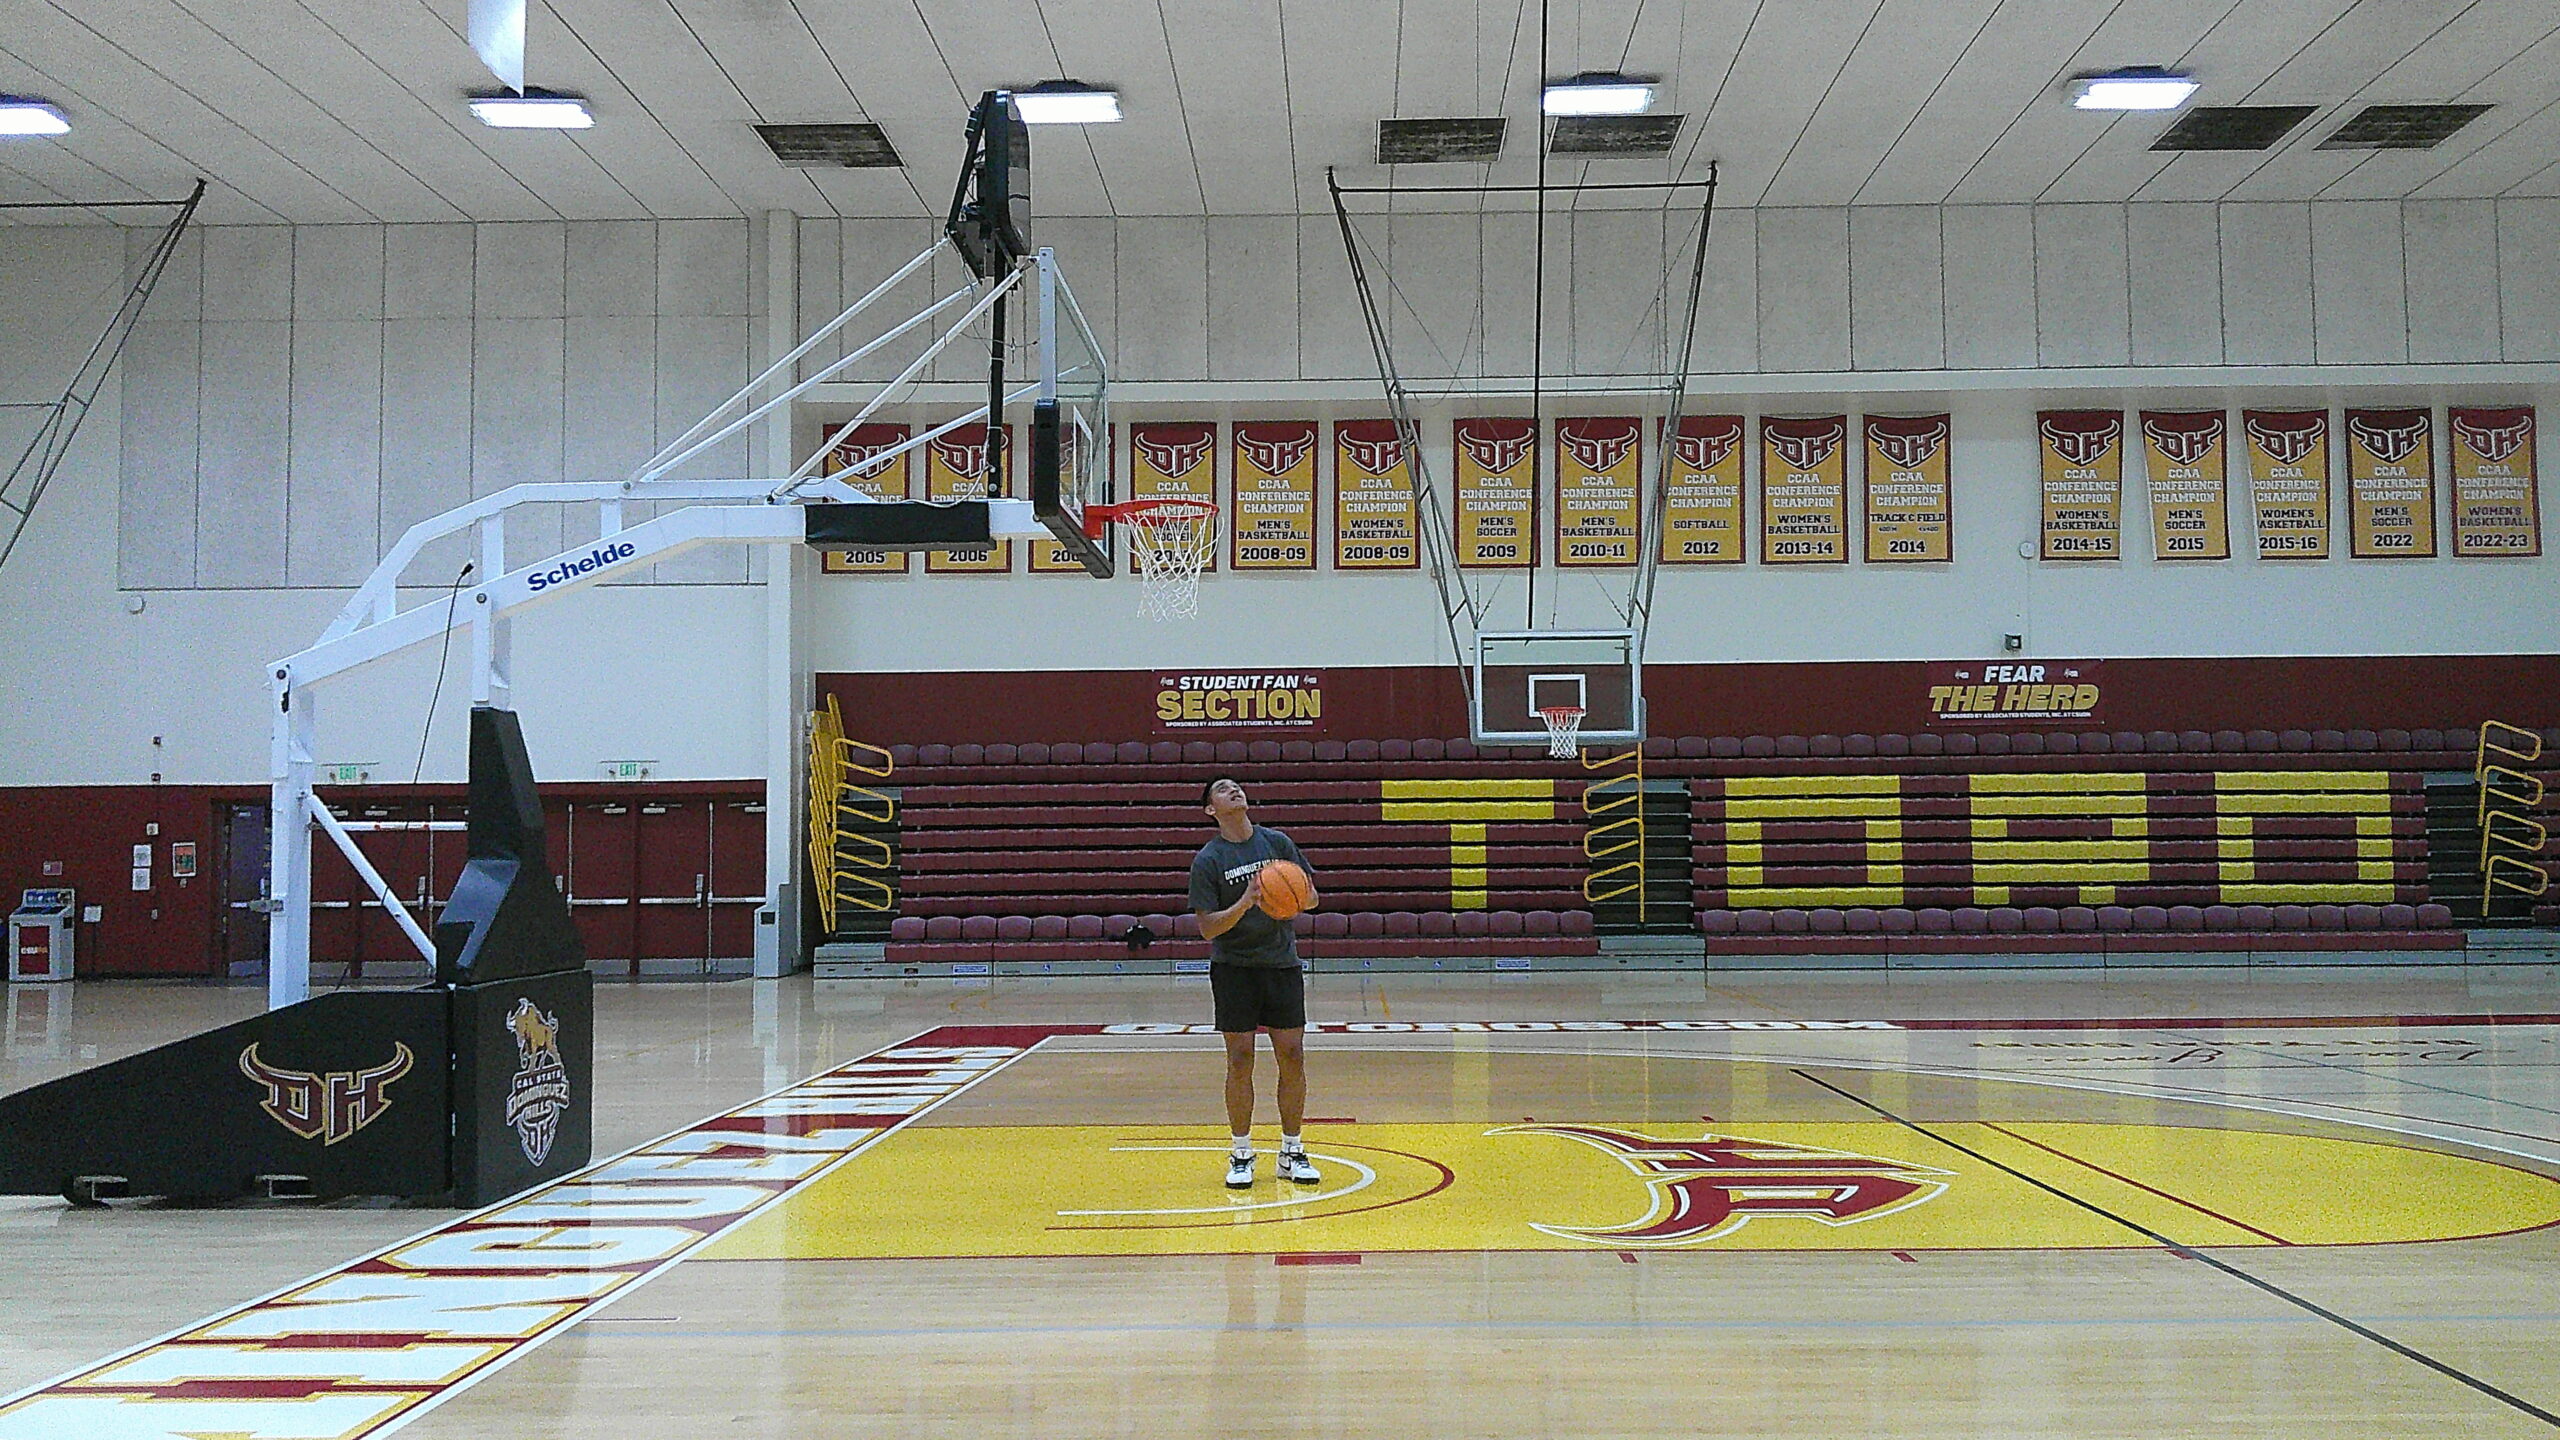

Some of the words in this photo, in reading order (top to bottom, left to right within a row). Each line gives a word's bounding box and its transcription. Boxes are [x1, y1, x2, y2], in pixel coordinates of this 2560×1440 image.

[2064, 469, 2097, 479] CCAA
[2168, 469, 2200, 478] CCAA
[2270, 468, 2303, 478] CCAA
[2374, 466, 2407, 476] CCAA
[2478, 465, 2512, 476] CCAA
[1480, 477, 1513, 487] CCAA
[1581, 477, 1614, 486] CCAA
[1685, 474, 1717, 484] CCAA
[1787, 474, 1820, 484] CCAA
[1890, 472, 1924, 482] CCAA
[1157, 482, 1189, 492] CCAA
[1258, 479, 1290, 489] CCAA
[1360, 479, 1392, 489] CCAA
[2044, 481, 2118, 491] CONFERENCE
[2253, 480, 2320, 490] CONFERENCE
[2354, 478, 2428, 488] CONFERENCE
[2456, 477, 2529, 488] CONFERENCE
[1460, 488, 1533, 499] CONFERENCE
[1562, 488, 1635, 498] CONFERENCE
[1767, 485, 1840, 495] CONFERENCE
[1870, 484, 1944, 494] CONFERENCE
[1238, 491, 1311, 501] CONFERENCE
[1340, 491, 1413, 501] CONFERENCE
[2051, 493, 2112, 504] CHAMPION
[2153, 492, 2215, 503] CHAMPION
[2257, 492, 2317, 502] CHAMPION
[2360, 490, 2422, 501] CHAMPION
[2463, 490, 2524, 500] CHAMPION
[1466, 500, 1527, 511] CHAMPION
[1567, 499, 1628, 511] CHAMPION
[1671, 497, 1731, 508] CHAMPION
[1772, 497, 1834, 508] CHAMPION
[1876, 496, 1937, 506] CHAMPION
[1243, 502, 1305, 513] CHAMPION
[1345, 502, 1407, 513] CHAMPION
[2374, 507, 2408, 516] MEN'S
[2468, 507, 2522, 516] WOMEN'S
[1777, 514, 1831, 524] WOMEN'S
[1870, 513, 1906, 522] TRACK
[1917, 513, 1946, 522] FIELD
[2055, 510, 2109, 519] WOMEN'S
[2168, 510, 2203, 519] MEN'S
[2261, 510, 2314, 518] WOMEN'S
[1257, 520, 1291, 529] MEN'S
[1350, 519, 1404, 528] WOMEN'S
[1480, 517, 1514, 526] MEN'S
[1581, 517, 1615, 526] MEN'S
[1673, 520, 1729, 529] SOFTBALL
[2046, 520, 2119, 530] BASKETBALL
[2164, 520, 2206, 530] SOCCER
[2259, 519, 2325, 529] ASKETBALL
[2371, 517, 2413, 527] SOCCER
[2459, 517, 2531, 527] BASKETBALL
[1238, 530, 1310, 540] BASKETBALL
[1341, 530, 1413, 539] BASKETBALL
[1476, 527, 1517, 537] SOCCER
[1562, 527, 1634, 537] BASKETBALL
[1768, 525, 1841, 535] BASKETBALL
[2053, 538, 2112, 551] 2014-15
[2167, 537, 2204, 550] 2015
[2259, 536, 2318, 550] 2015-16
[2373, 534, 2413, 547] 2022
[2464, 534, 2528, 547] 2022-23
[1476, 545, 1517, 558] 2009
[1570, 544, 1626, 557] 2010-11
[1683, 541, 1719, 555] 2012
[1774, 541, 1833, 554] 2013-14
[1889, 540, 1926, 553] 2014
[845, 552, 885, 564] 2005
[949, 551, 988, 562] 2006
[1240, 547, 1306, 560] 2008-09
[1343, 546, 1410, 560] 2008-09
[527, 542, 636, 592] Schelde
[1984, 665, 2046, 683] FEAR
[1178, 675, 1260, 690] STUDENT
[1263, 675, 1299, 689] FAN
[1929, 685, 1998, 712] THE
[2001, 684, 2100, 711] HERD
[1156, 688, 1322, 721] SECTION
[1224, 860, 1261, 880] DOMINGUEZ
[516, 1077, 534, 1090] CAL
[536, 1070, 562, 1083] STATE
[726, 1046, 1027, 1117] HILLS
[508, 1082, 569, 1113] DOMINGUEZ
[525, 1101, 552, 1121] HILLS
